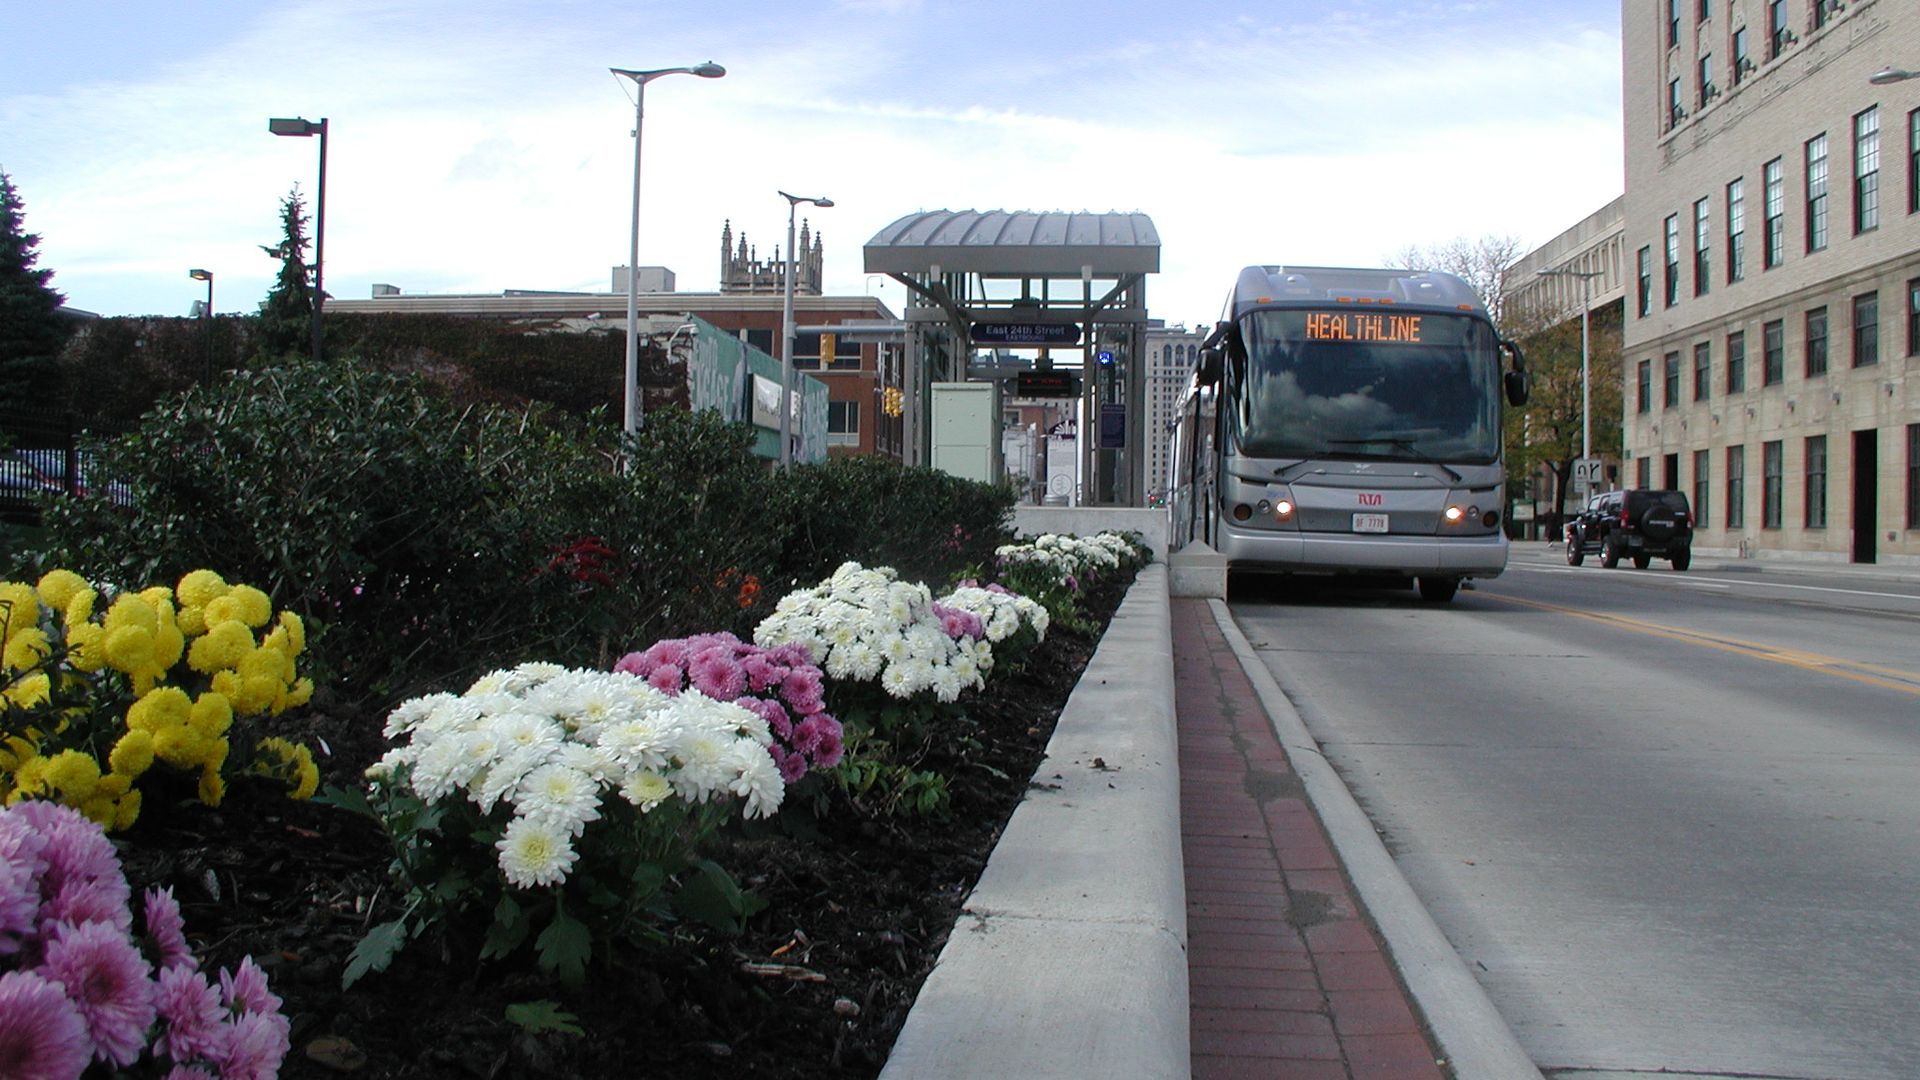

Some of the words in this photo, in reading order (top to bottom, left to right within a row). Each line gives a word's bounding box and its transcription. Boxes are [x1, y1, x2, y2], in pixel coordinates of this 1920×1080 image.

[986, 325, 1008, 334] East
[1009, 325, 1032, 334] 24th
[1035, 325, 1065, 334] Street
[1306, 313, 1421, 342] HEALTHLINE
[1359, 494, 1381, 505] RTA
